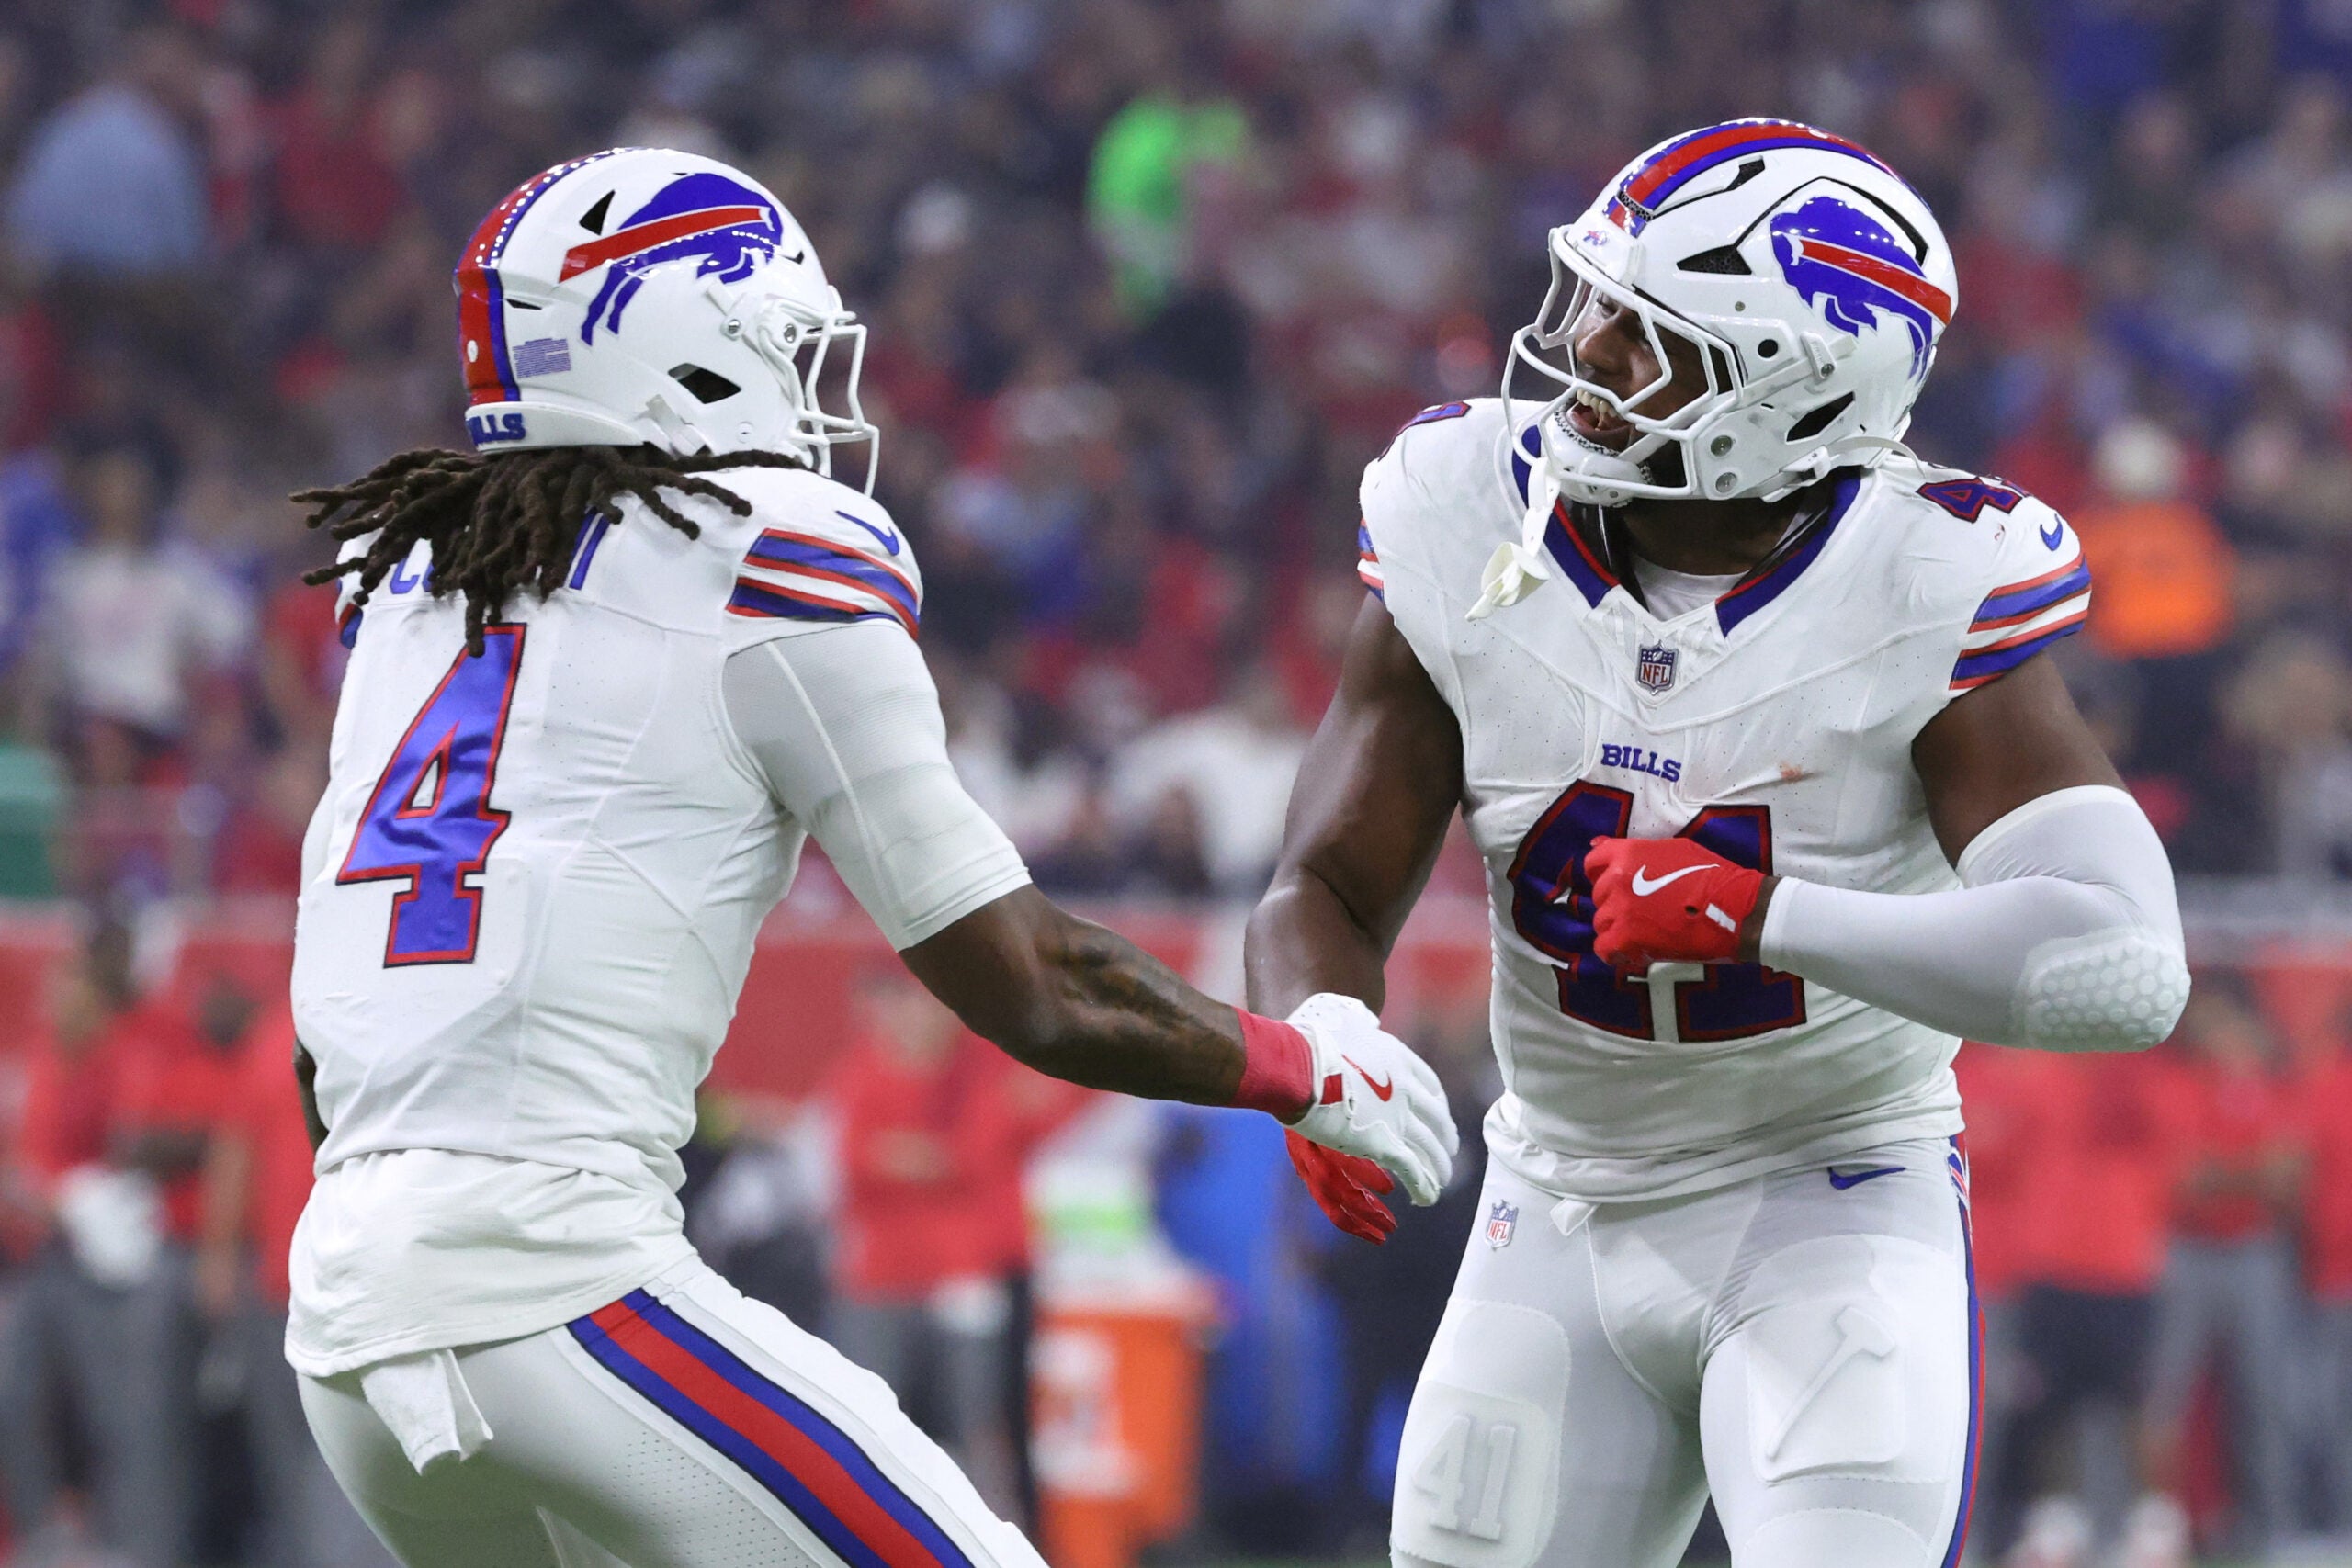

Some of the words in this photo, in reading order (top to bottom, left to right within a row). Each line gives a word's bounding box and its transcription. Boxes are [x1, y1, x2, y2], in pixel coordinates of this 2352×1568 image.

[1643, 663, 1668, 685] NFL
[335, 622, 527, 968] 4
[1600, 744, 1682, 783] BILLS
[1411, 1414, 1517, 1541] 41
